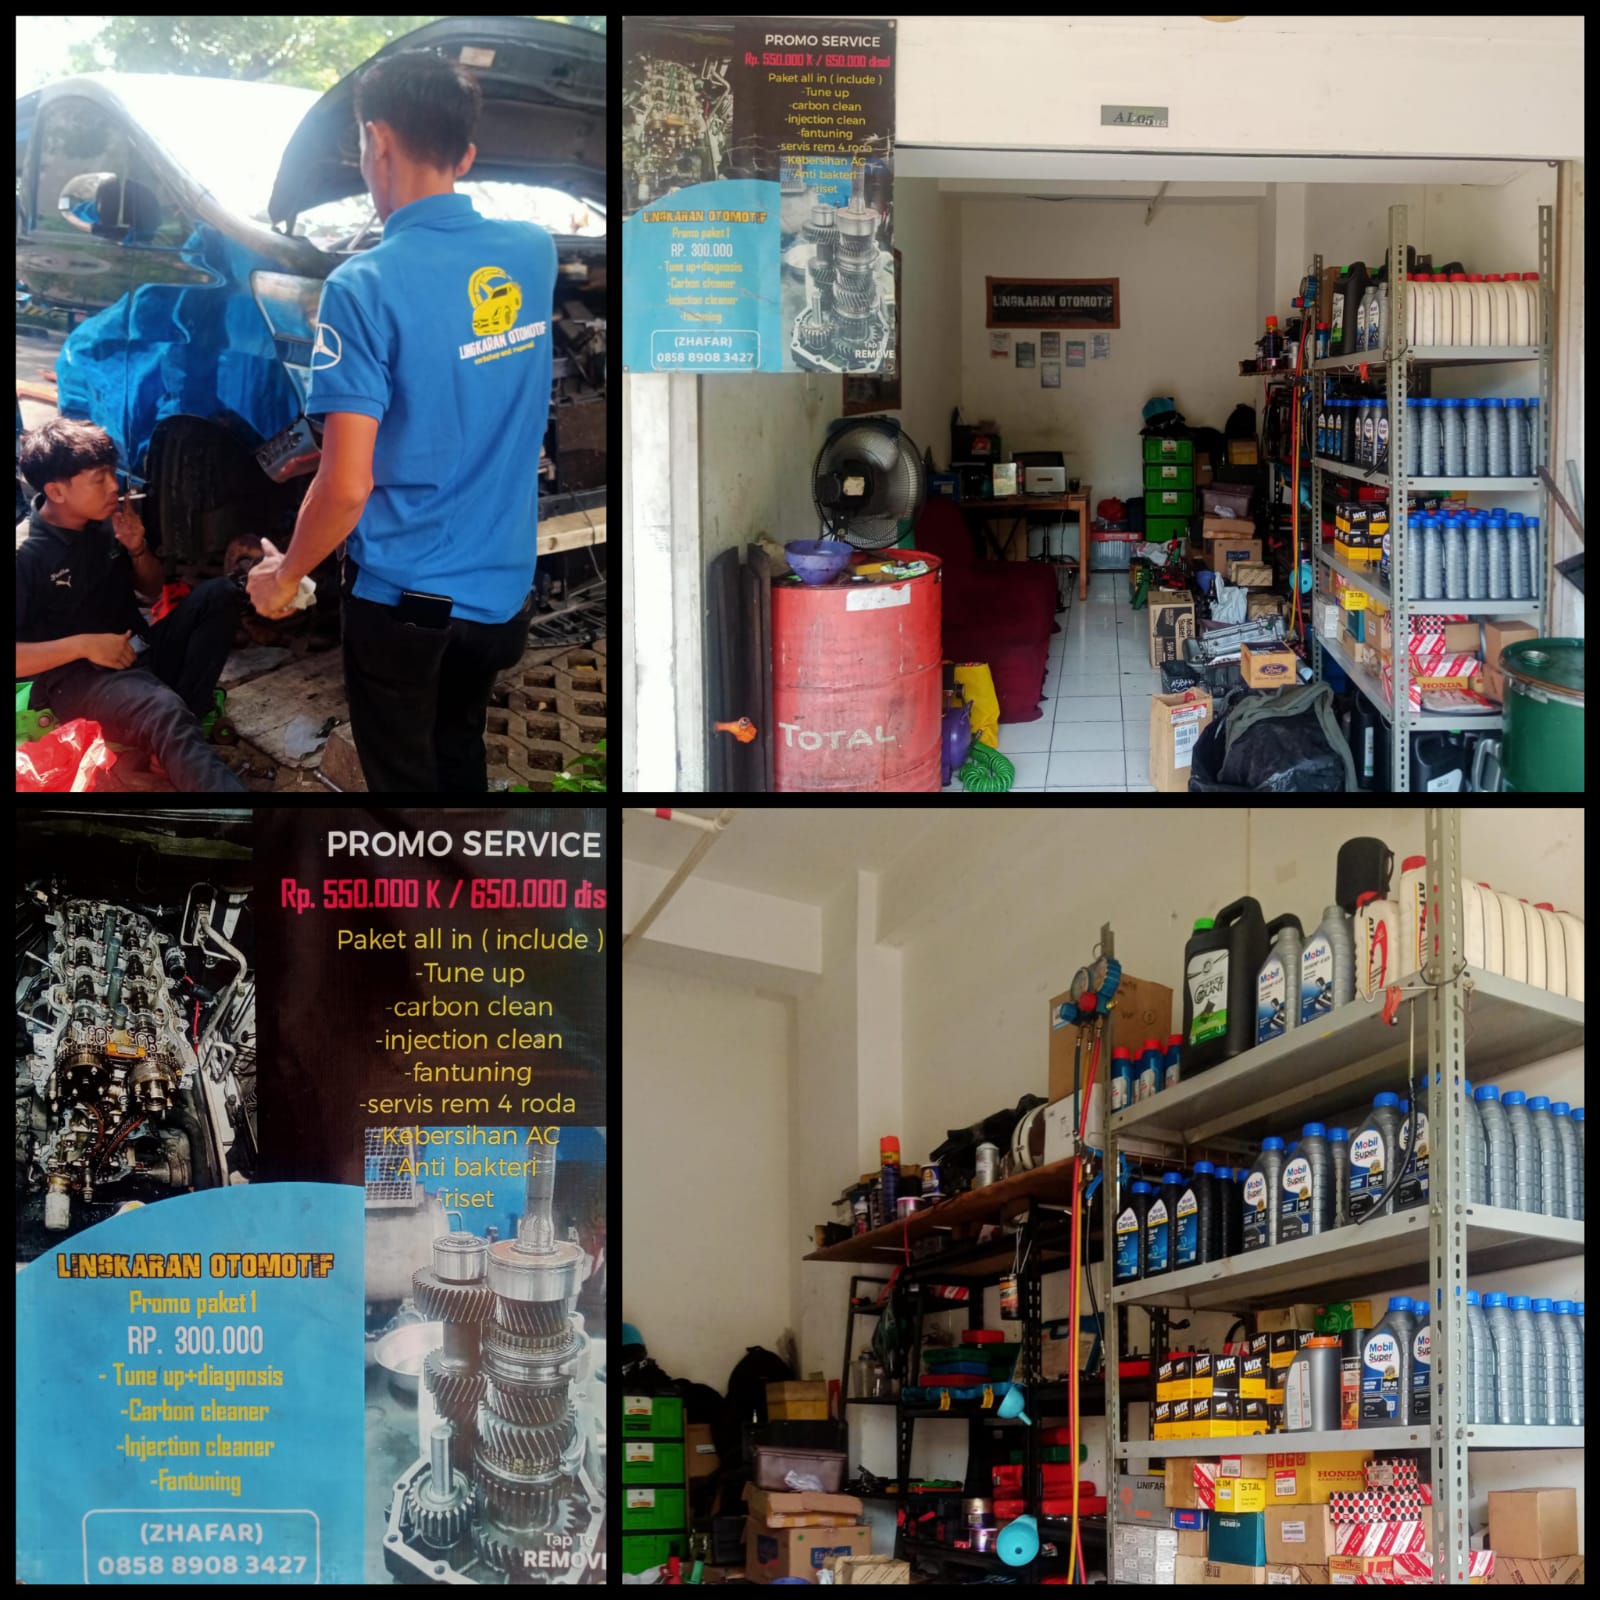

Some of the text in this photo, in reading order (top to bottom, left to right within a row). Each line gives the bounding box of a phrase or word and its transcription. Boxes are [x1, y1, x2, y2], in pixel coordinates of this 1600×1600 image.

[765, 34, 881, 48] PROMO SERVICE
[768, 73, 798, 83] Paket
[801, 73, 814, 83] all
[817, 74, 827, 83] in
[837, 74, 875, 85] include
[834, 89, 850, 99] up
[832, 101, 862, 111] clean
[837, 114, 866, 125] clean
[813, 144, 835, 152] rem
[838, 142, 845, 152] 4
[851, 156, 866, 166] AC
[642, 210, 768, 224] LINGKARAN OTOMOTIF
[671, 243, 733, 257] RP. 300.000
[993, 295, 1113, 307] LINGKARAN OTOMOTIF
[674, 336, 733, 348] (ZHAFAR)
[657, 353, 754, 363] 0858 8908 3427
[855, 350, 896, 359] REMOVE
[778, 722, 896, 750] TOTAL
[328, 830, 601, 858] PROMO SERVICE
[281, 878, 315, 914] Rp.
[323, 879, 419, 909] 550.000
[427, 879, 441, 909] K
[449, 879, 463, 909] /
[471, 879, 567, 909] 650.000
[338, 928, 406, 951] Paket
[415, 928, 442, 950] all
[452, 928, 472, 950] in
[497, 928, 589, 951] include
[1304, 946, 1326, 961] Mobil
[415, 963, 525, 988] -Tune up
[1260, 967, 1280, 984] Mobil
[385, 996, 553, 1018] -carbon clean
[375, 1029, 562, 1055] -injection clean
[404, 1062, 532, 1085] -fantuning
[359, 1093, 576, 1114] -servis rem 4 roda
[372, 1125, 561, 1146] -Kebersihan AC
[1354, 1137, 1378, 1151] Mobil
[1354, 1148, 1377, 1160] Super
[389, 1157, 538, 1177] -Anti bakteri
[1287, 1165, 1307, 1176] Mobil
[1247, 1179, 1263, 1189] Mobil
[1287, 1175, 1306, 1187] Super
[57, 1252, 335, 1279] LINGKARAN OTOMOTIF
[129, 1290, 257, 1318] Promo paket 1
[127, 1326, 264, 1355] RP. 300.000
[1253, 1335, 1267, 1348] WIX
[1369, 1342, 1393, 1352] Mobil
[1195, 1356, 1210, 1372] WIX
[1216, 1357, 1235, 1370] WIX
[1244, 1358, 1262, 1371] WIX
[1369, 1353, 1392, 1362] Super
[1159, 1361, 1172, 1376] WIX
[113, 1364, 159, 1387] Tune
[163, 1365, 283, 1392] up+diagnosis
[120, 1398, 269, 1422] -Carbon cleaner
[1156, 1402, 1170, 1416] WIX
[1174, 1401, 1188, 1414] WIX
[1194, 1399, 1209, 1413] WIX
[116, 1433, 275, 1461] -Injection cleaner
[150, 1468, 242, 1496] -Fantuning
[140, 1522, 264, 1545] (ZHAFAR)
[544, 1532, 572, 1549] Tap
[98, 1554, 307, 1575] 0858 8908 3427
